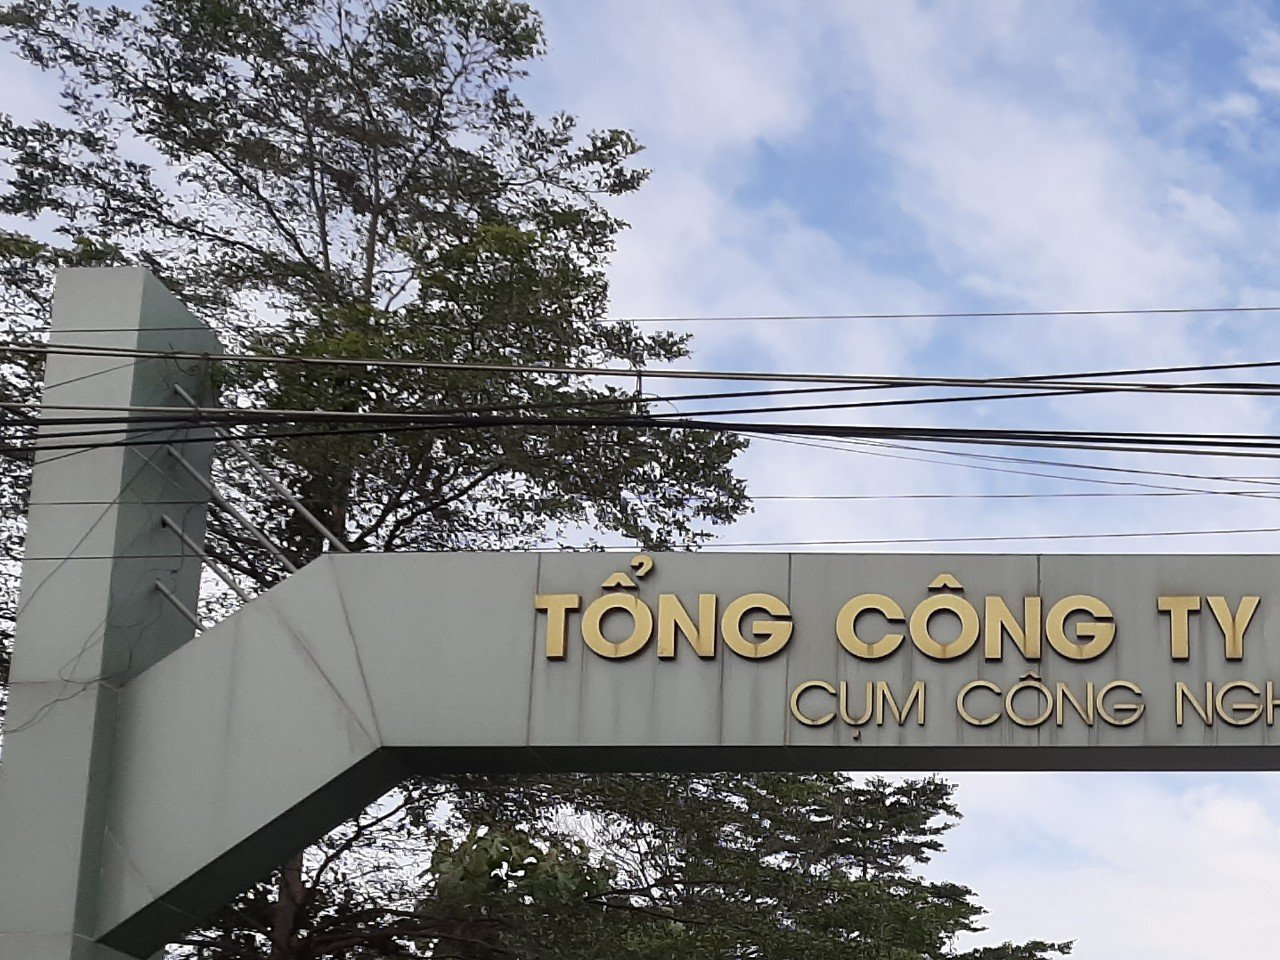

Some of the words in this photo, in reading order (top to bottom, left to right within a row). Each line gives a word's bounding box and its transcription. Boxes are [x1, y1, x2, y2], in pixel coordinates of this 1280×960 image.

[535, 555, 793, 661] TỔNG
[836, 573, 1117, 663] CÔNG
[1157, 595, 1260, 660] TY
[790, 680, 925, 739] CỤM
[956, 671, 1146, 728] CÔNG
